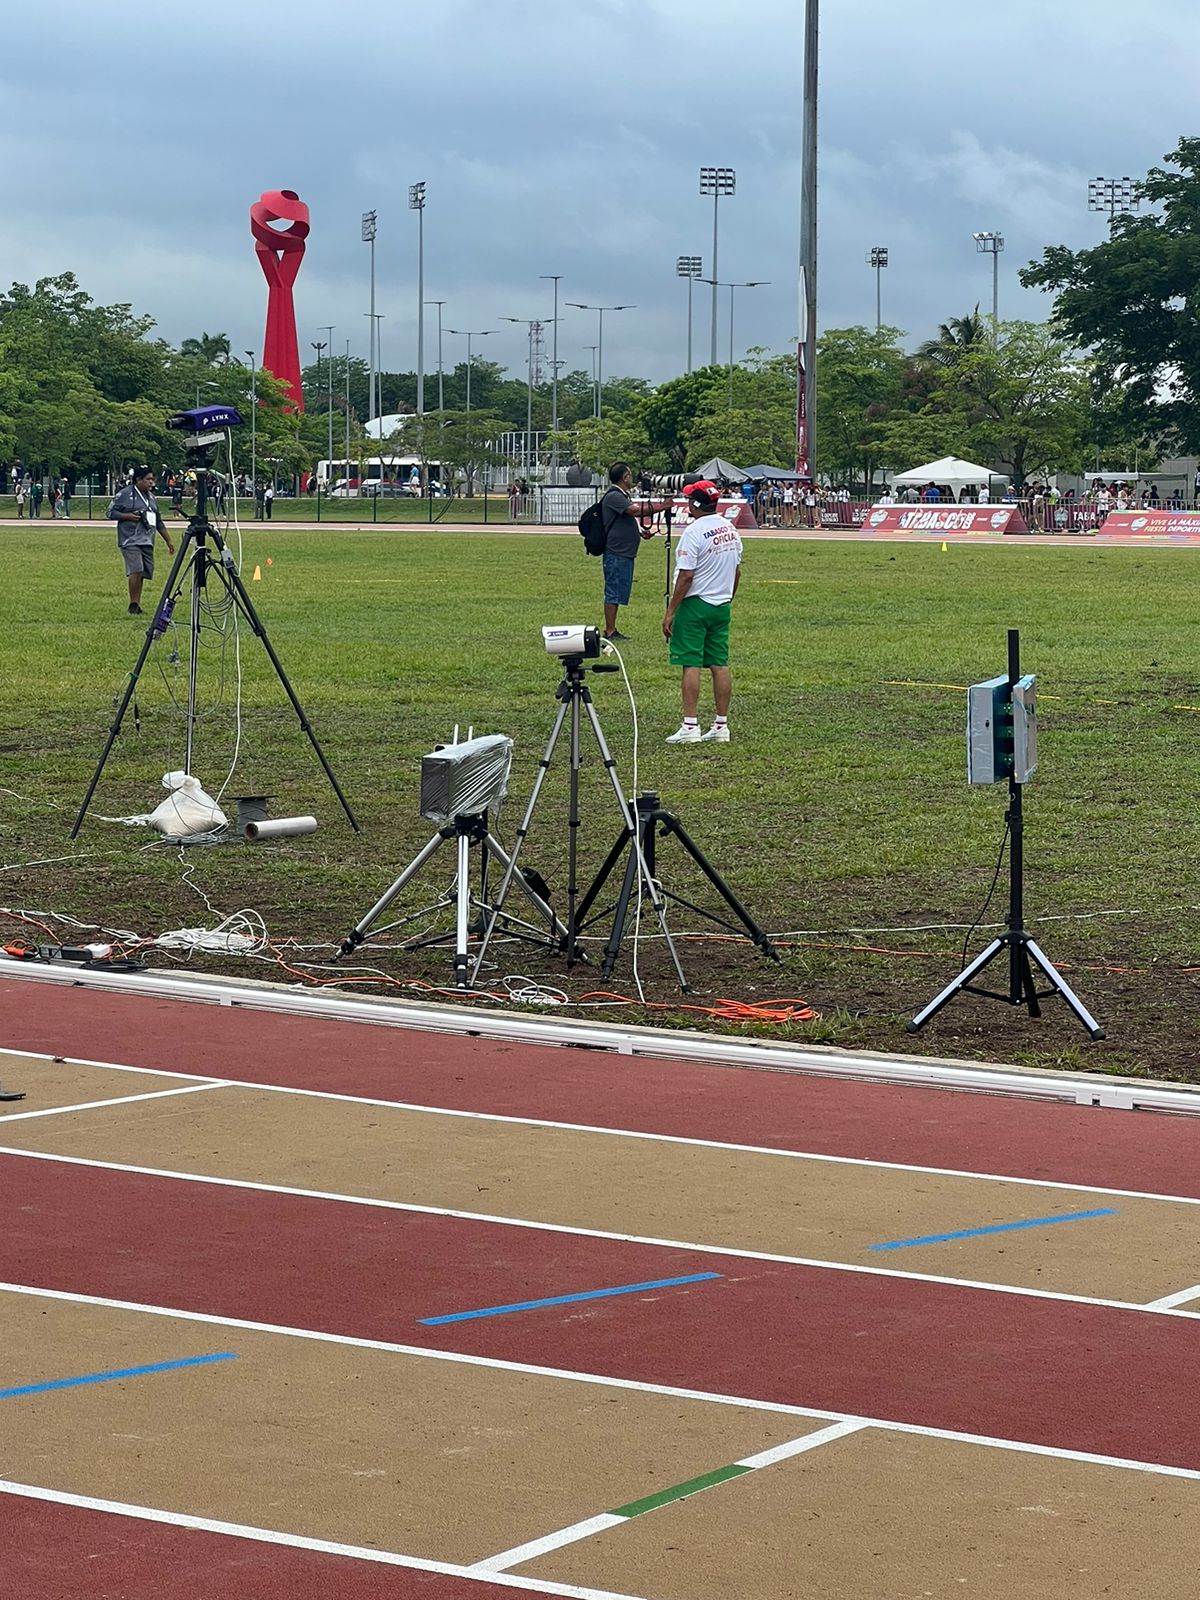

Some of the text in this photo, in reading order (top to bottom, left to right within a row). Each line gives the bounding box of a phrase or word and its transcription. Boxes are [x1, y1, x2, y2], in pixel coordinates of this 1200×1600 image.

[212, 413, 229, 422] LYNX
[1177, 517, 1200, 526] MÁXI
[703, 526, 728, 540] TABASCO
